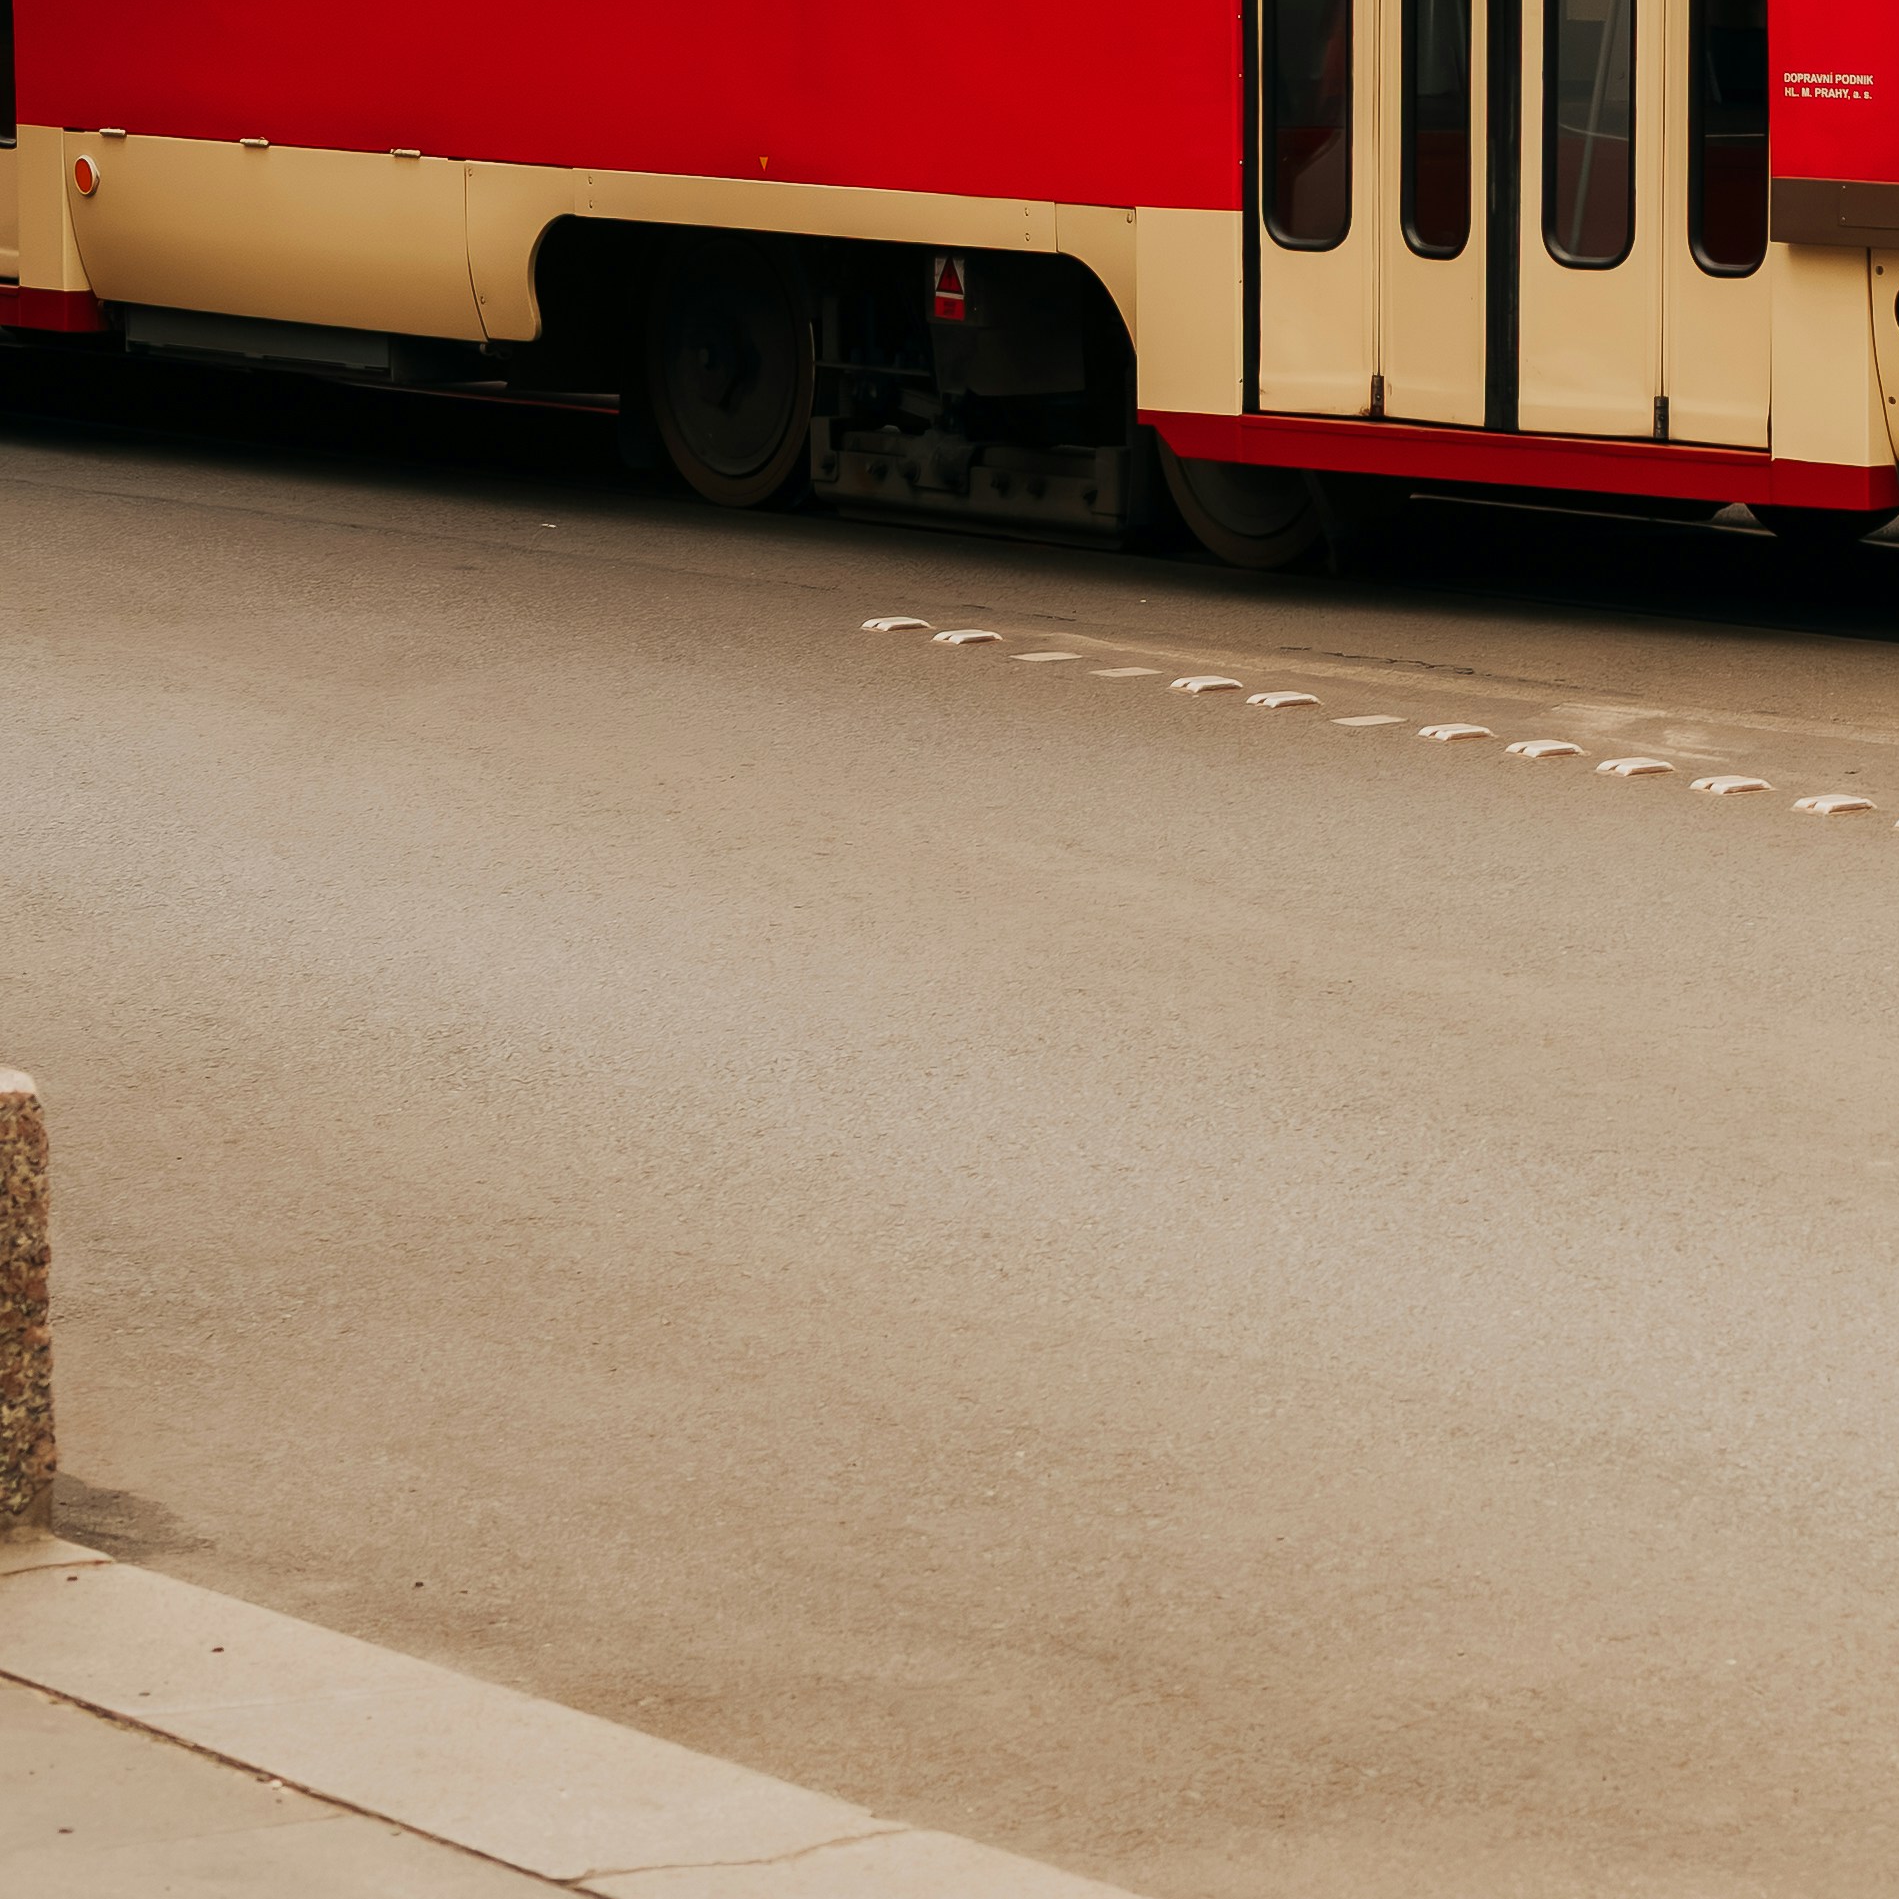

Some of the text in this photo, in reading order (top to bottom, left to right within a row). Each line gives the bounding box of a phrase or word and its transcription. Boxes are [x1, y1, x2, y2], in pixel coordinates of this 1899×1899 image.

[1784, 71, 1874, 86] DOPRAVNÍ PODNIK
[1784, 86, 1800, 97] HL.
[1814, 87, 1851, 100] PRAHY,
